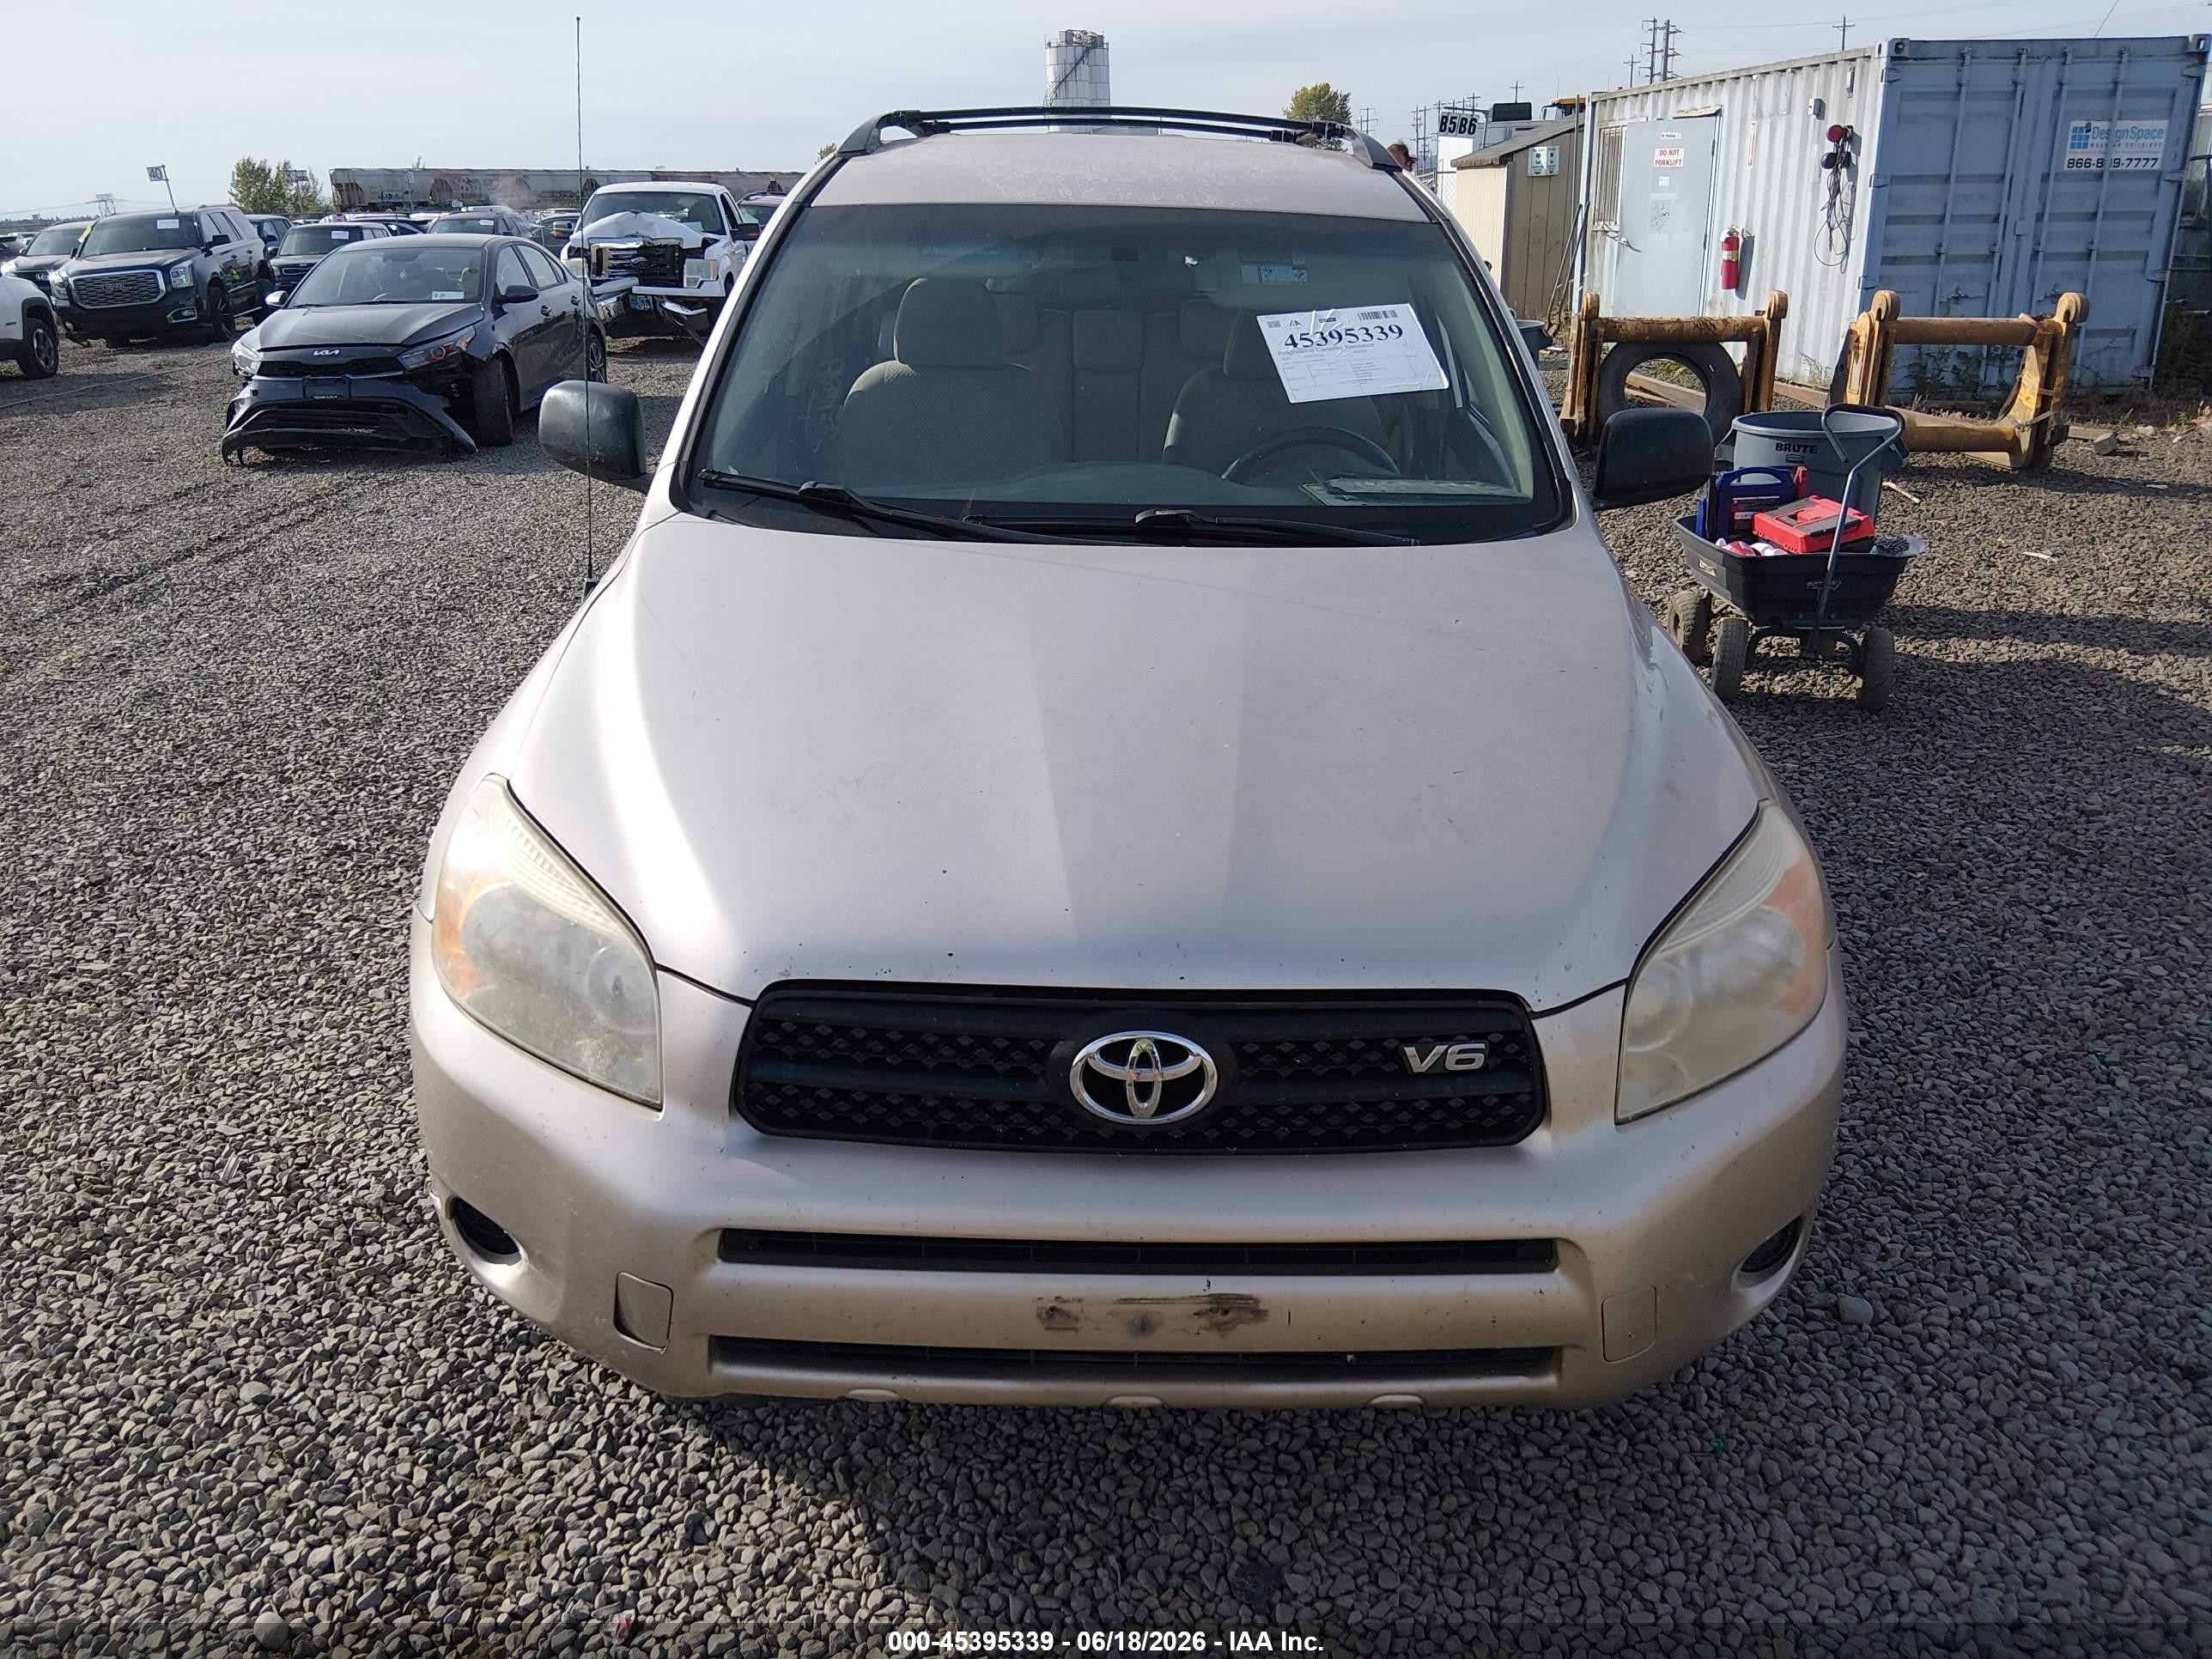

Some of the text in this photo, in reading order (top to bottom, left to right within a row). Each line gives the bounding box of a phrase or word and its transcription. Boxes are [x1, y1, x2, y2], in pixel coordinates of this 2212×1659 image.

[1439, 115, 1478, 135] B5 B6
[2092, 126, 2165, 143] DesgnSpace
[2067, 157, 2159, 168] 866-89-7777
[149, 168, 163, 179] 40
[1284, 324, 1403, 349] 45395339
[1775, 442, 1818, 454] BRUTE
[1402, 1042, 1487, 1073] V6
